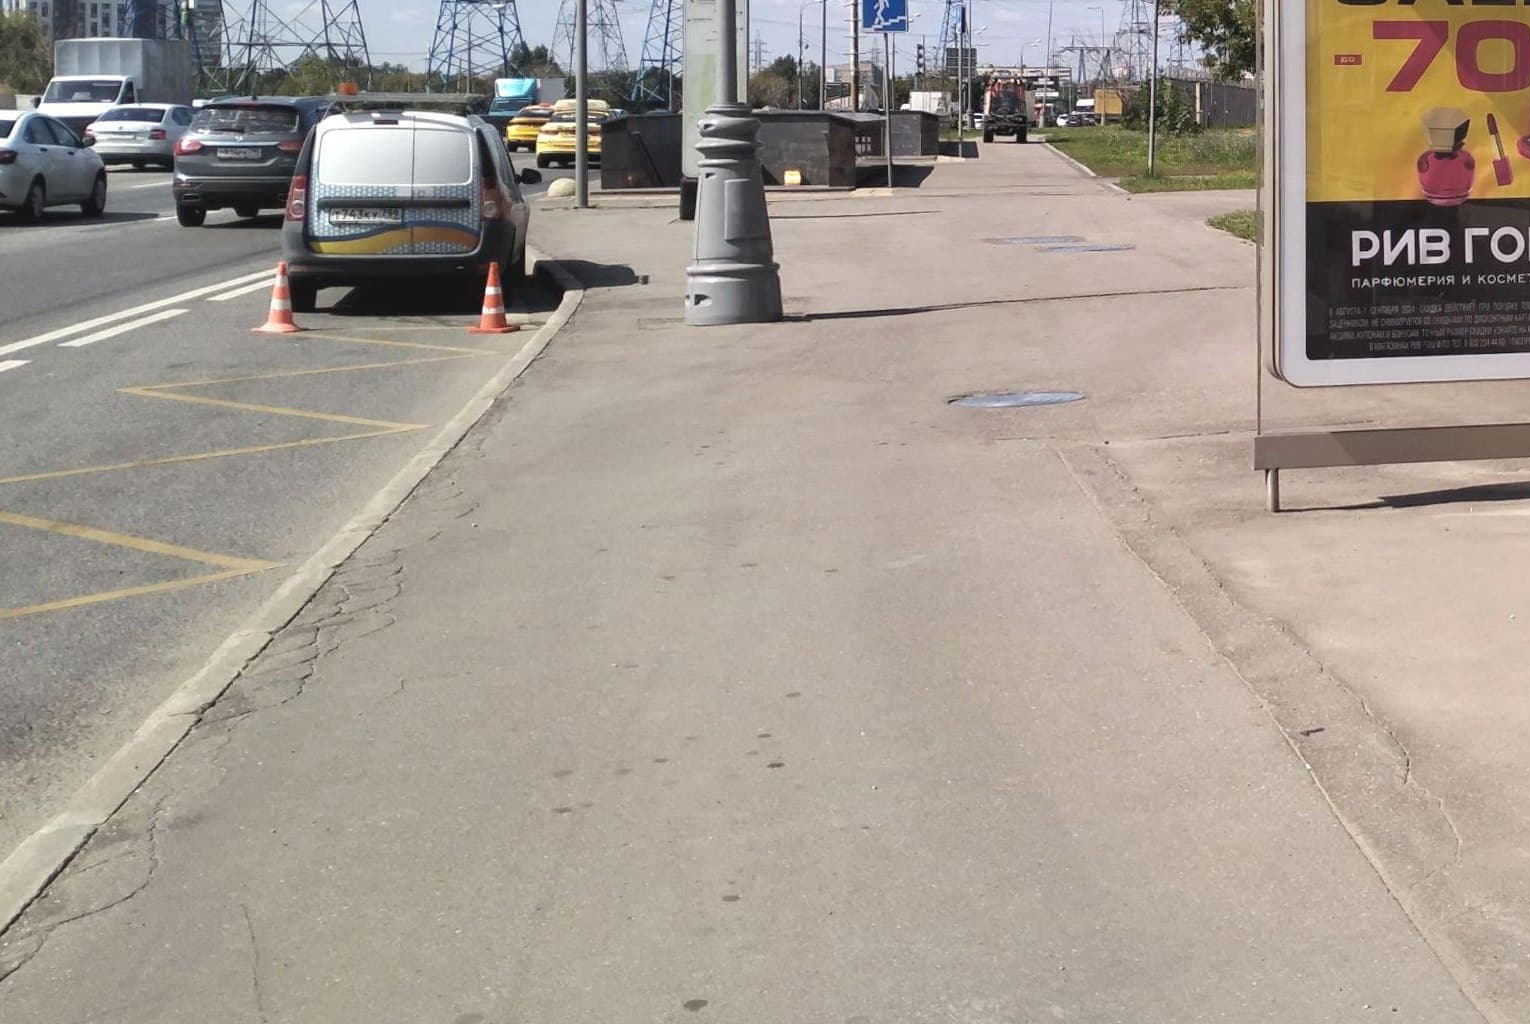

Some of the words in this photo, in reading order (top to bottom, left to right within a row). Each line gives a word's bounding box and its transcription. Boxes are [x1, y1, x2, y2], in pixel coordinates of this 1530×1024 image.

[1351, 228, 1451, 268] РИВ
[1351, 275, 1455, 289] ПАРФЮМЕРИЯ
[1462, 275, 1471, 285] И
